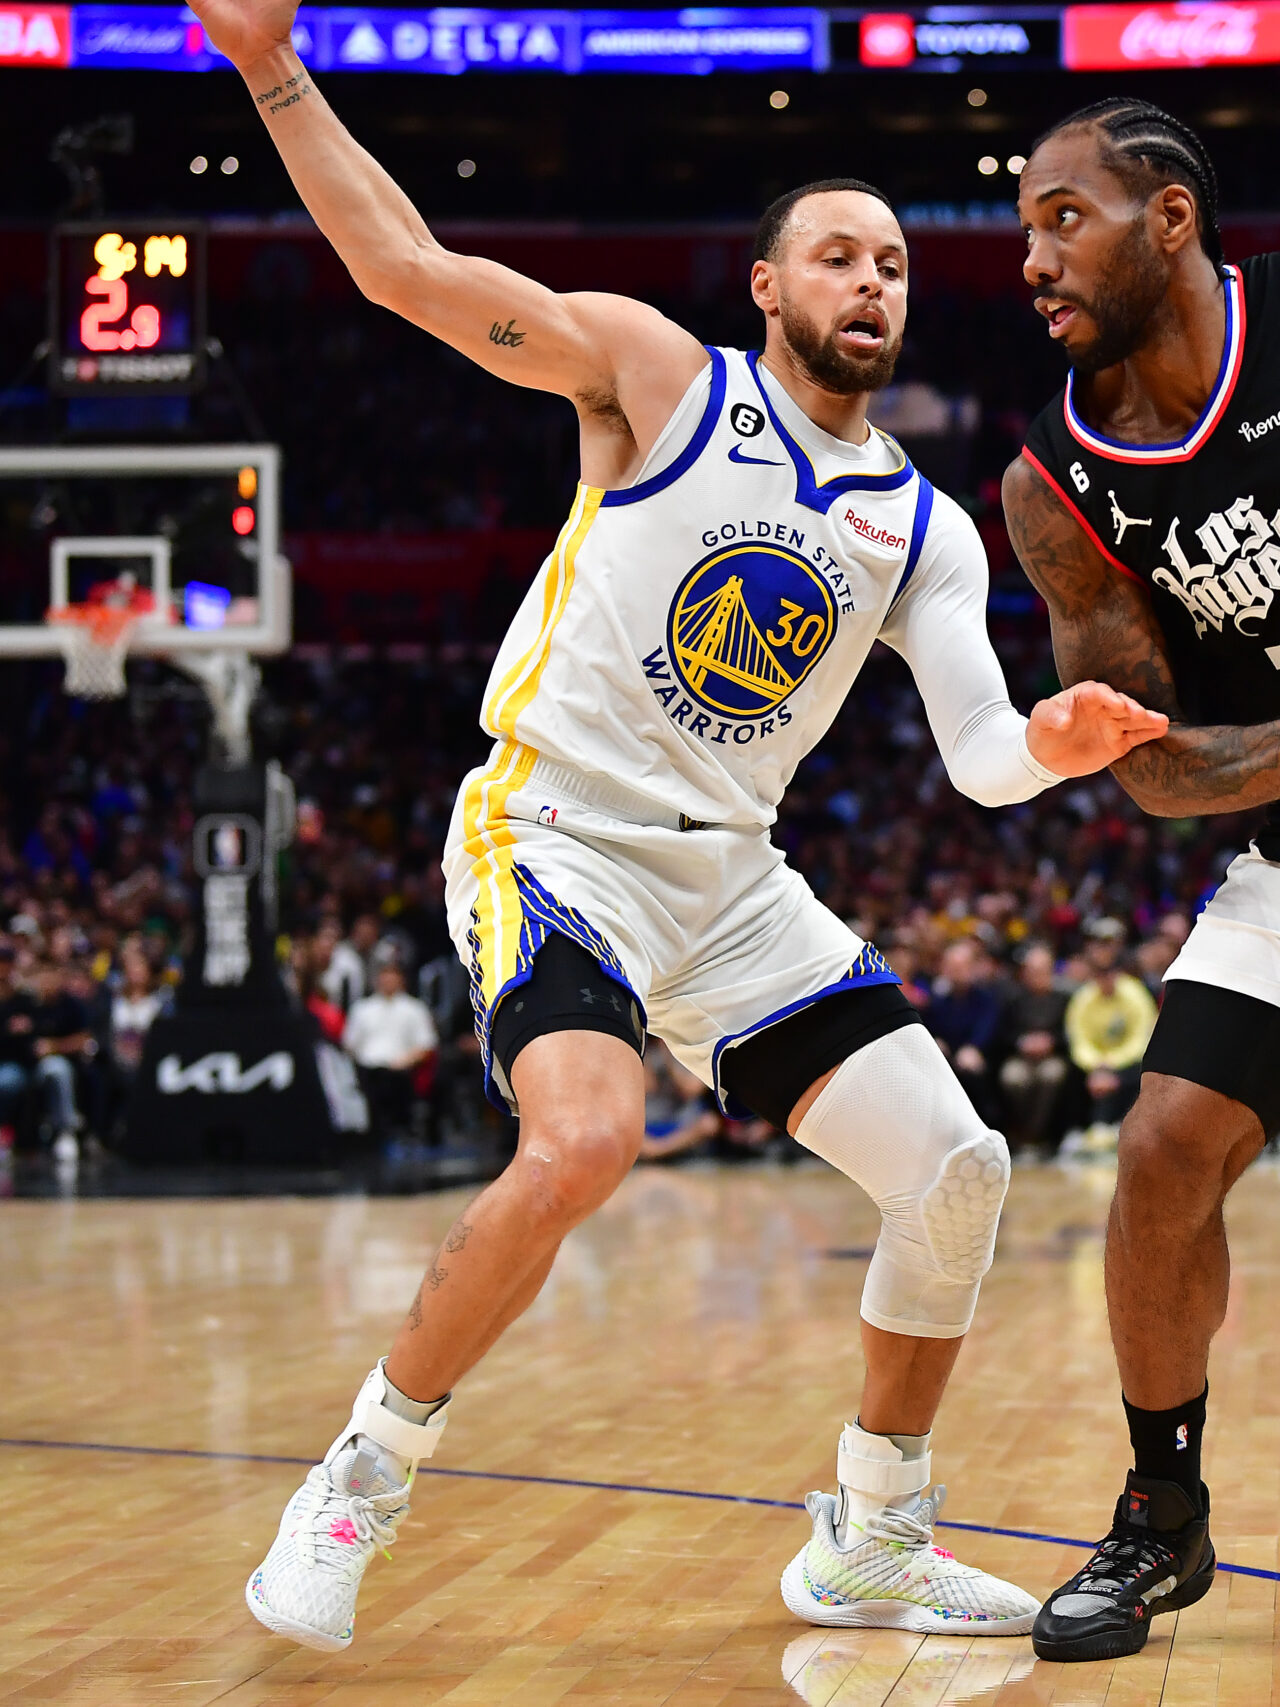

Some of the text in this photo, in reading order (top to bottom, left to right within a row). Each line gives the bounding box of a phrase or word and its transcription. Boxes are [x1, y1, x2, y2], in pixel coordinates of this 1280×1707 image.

[390, 22, 558, 62] DELTA
[915, 24, 1029, 54] TOYOTA
[735, 407, 758, 434] 6
[1069, 460, 1091, 494] 6
[843, 508, 907, 551] Rakuten
[1160, 495, 1274, 588] Los
[701, 520, 856, 615] GOLDEN STATE
[766, 597, 826, 658] 30
[641, 644, 793, 745] WARRIORS
